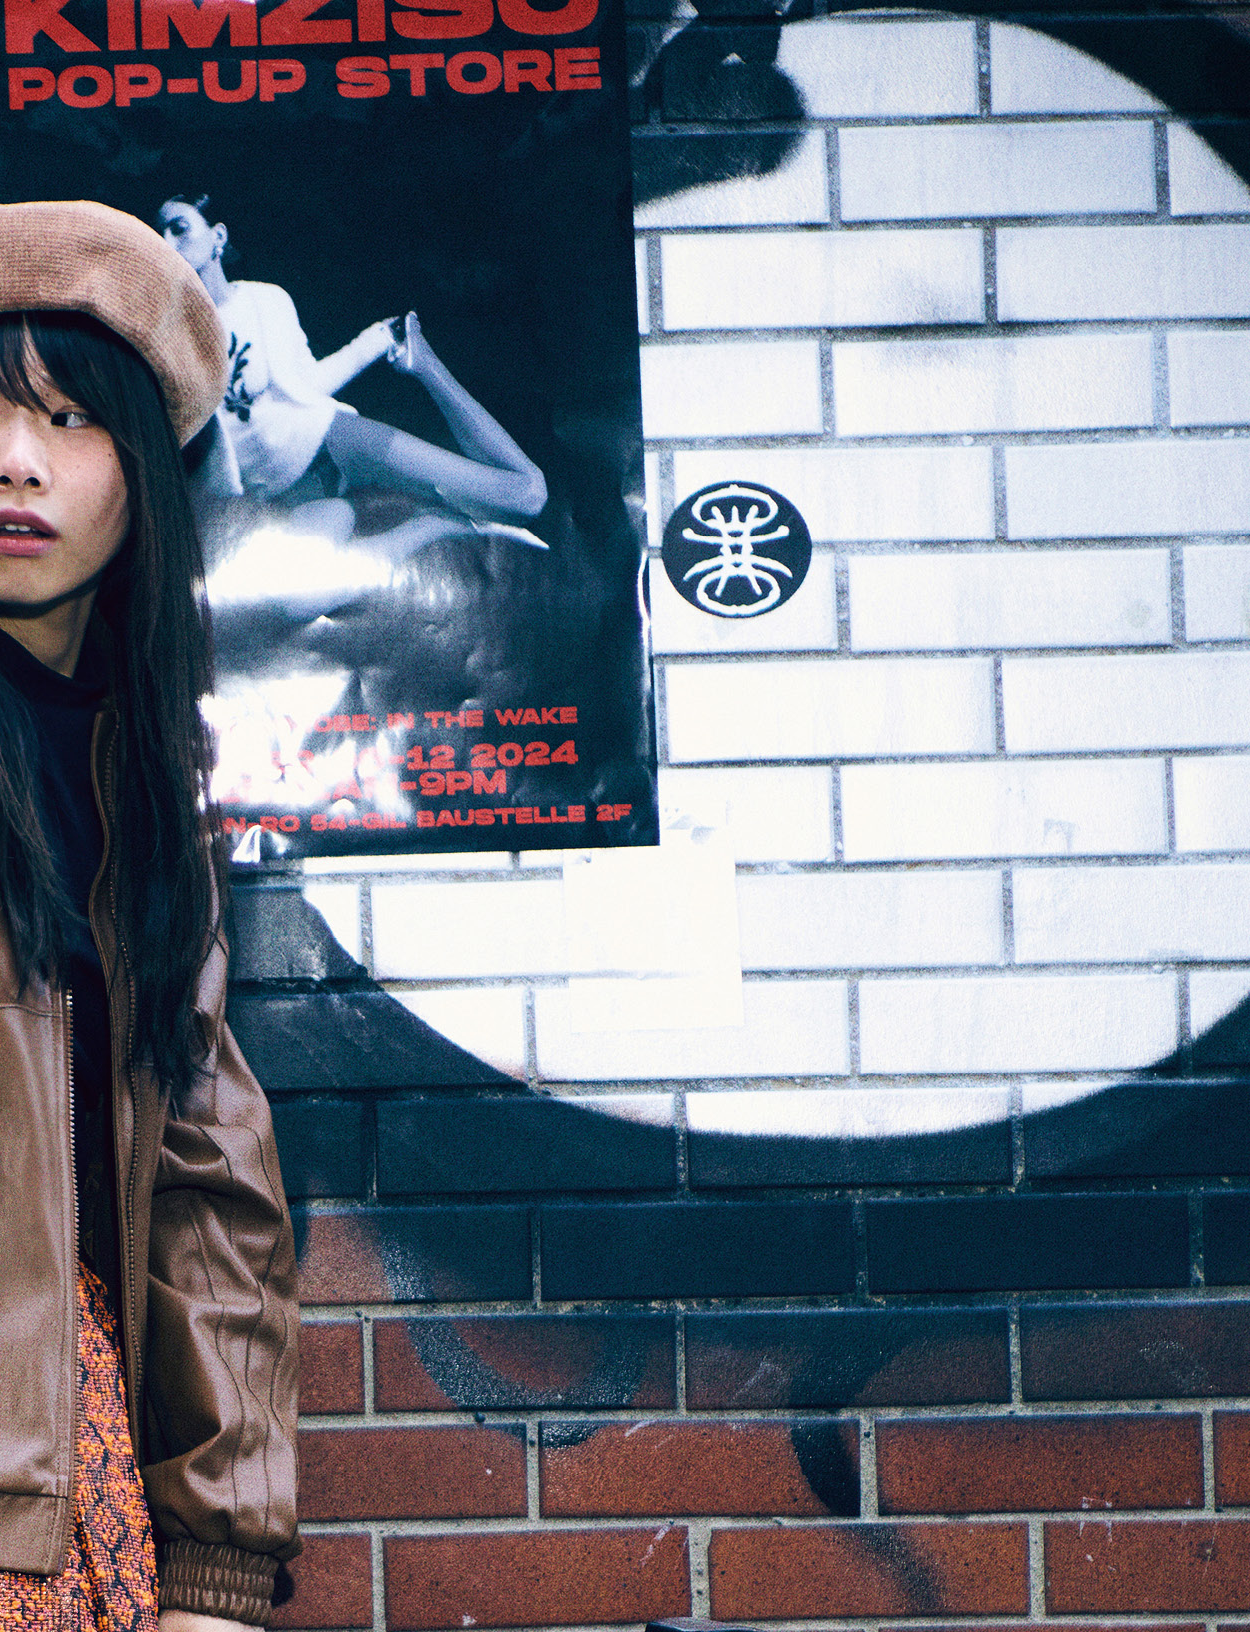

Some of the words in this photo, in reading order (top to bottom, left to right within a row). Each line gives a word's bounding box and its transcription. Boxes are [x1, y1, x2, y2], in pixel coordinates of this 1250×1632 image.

[7, 58, 306, 109] POP-UP
[336, 46, 602, 98] STORE
[386, 711, 415, 730] IN
[424, 709, 484, 728] THE
[494, 707, 578, 725] WAKE
[470, 740, 578, 768] 2024
[310, 811, 408, 832] 54-GIL
[417, 804, 586, 828] BAUSTELLE
[596, 803, 633, 821] 2F
